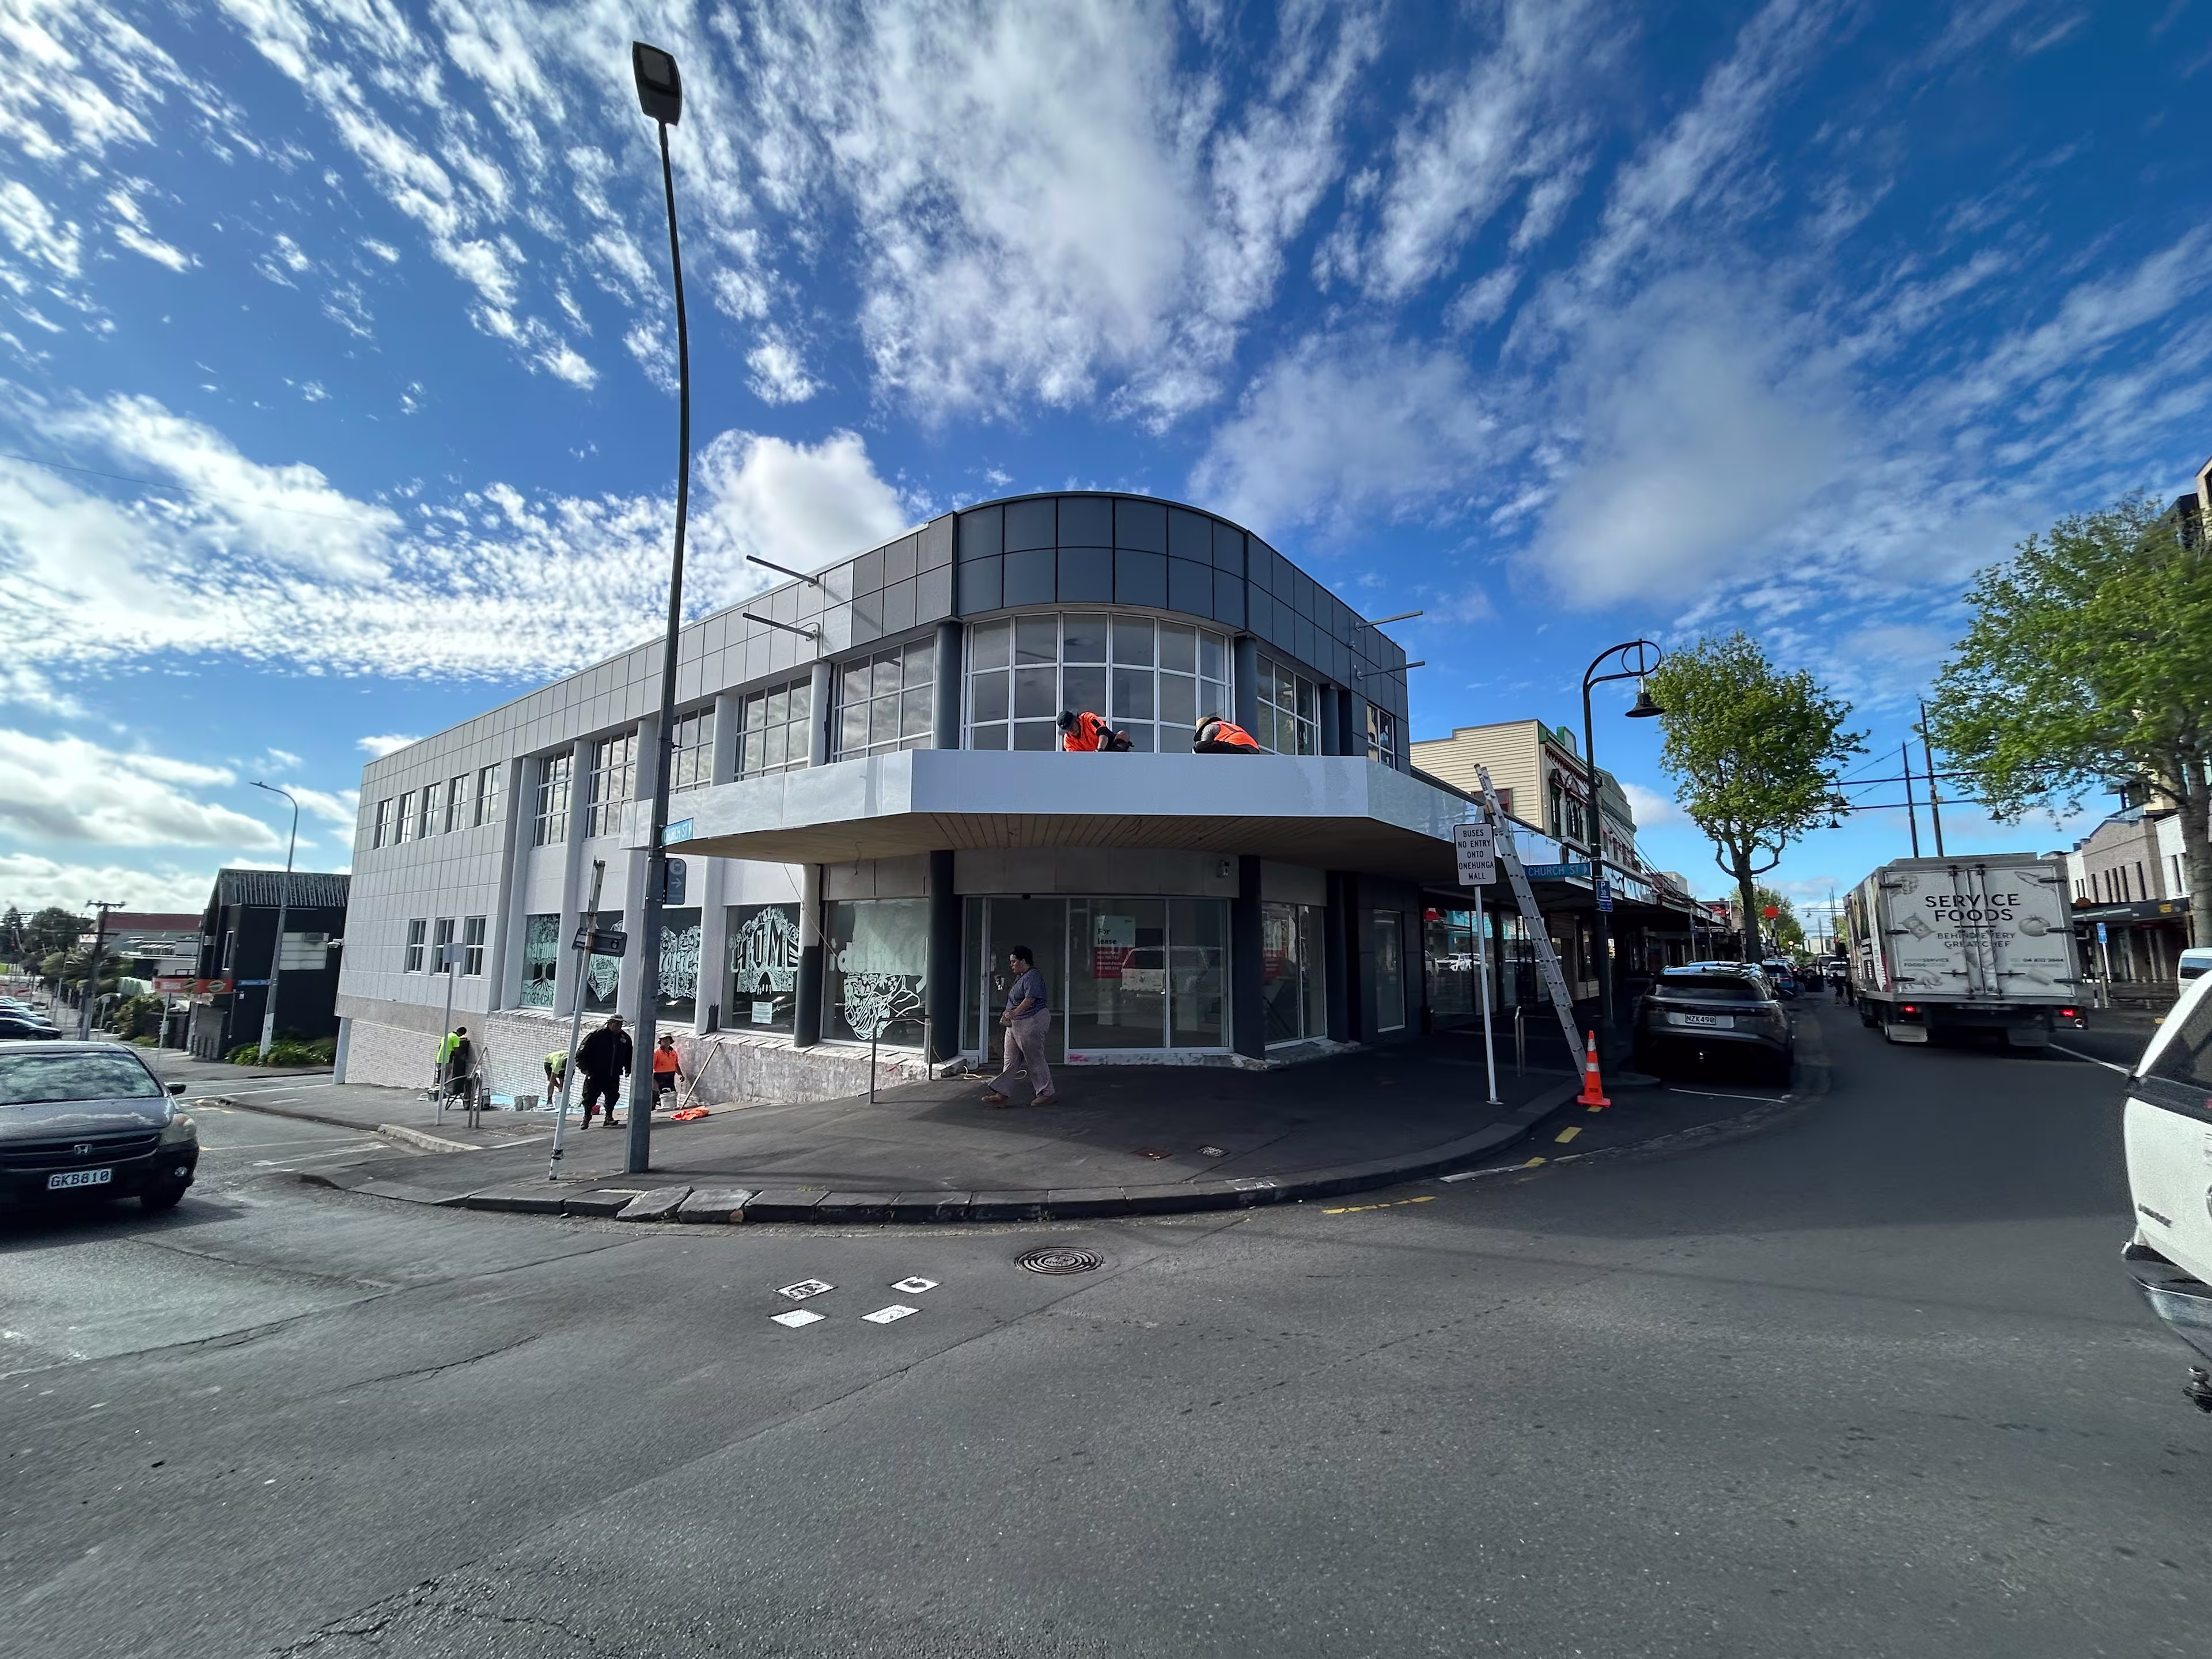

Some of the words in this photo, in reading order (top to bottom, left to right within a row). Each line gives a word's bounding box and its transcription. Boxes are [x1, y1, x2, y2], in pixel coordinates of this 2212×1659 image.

[682, 823, 688, 839] ST
[1463, 829, 1484, 837] BUSES
[1458, 840, 1467, 849] NO
[1470, 839, 1491, 848] ENTRY
[1459, 861, 1494, 870] ONEHUNGA
[1528, 866, 1565, 877] CHURCH
[1570, 866, 1580, 874] ST
[1468, 872, 1486, 880] MALL
[1925, 893, 2020, 908] SERVICE
[1934, 908, 2013, 922] FOODS
[730, 913, 798, 974] HOME
[51, 1171, 109, 1187] GKB810
